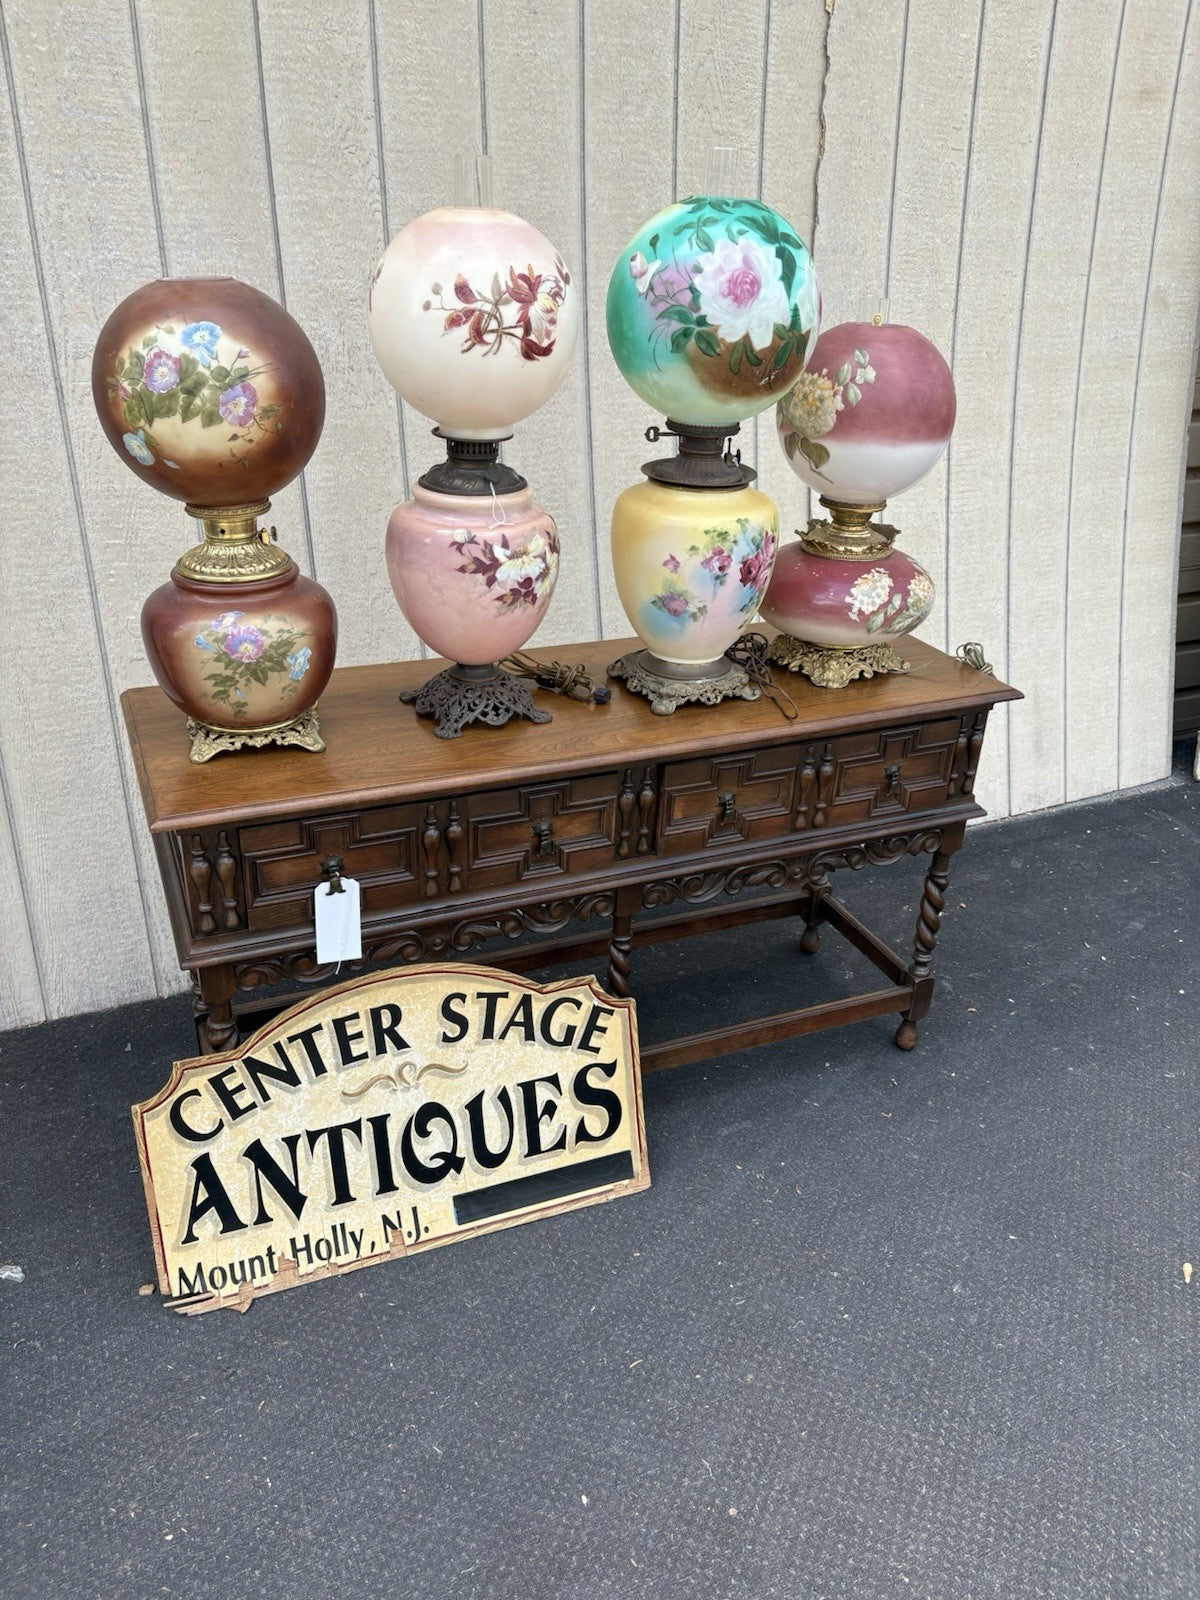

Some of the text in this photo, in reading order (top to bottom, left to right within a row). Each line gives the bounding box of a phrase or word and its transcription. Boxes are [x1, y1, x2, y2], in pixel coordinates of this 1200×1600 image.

[169, 991, 616, 1142] CENTER STAGE
[181, 1060, 624, 1245] ANTIQUES
[178, 1206, 430, 1295] Mount Holly, N.J.
